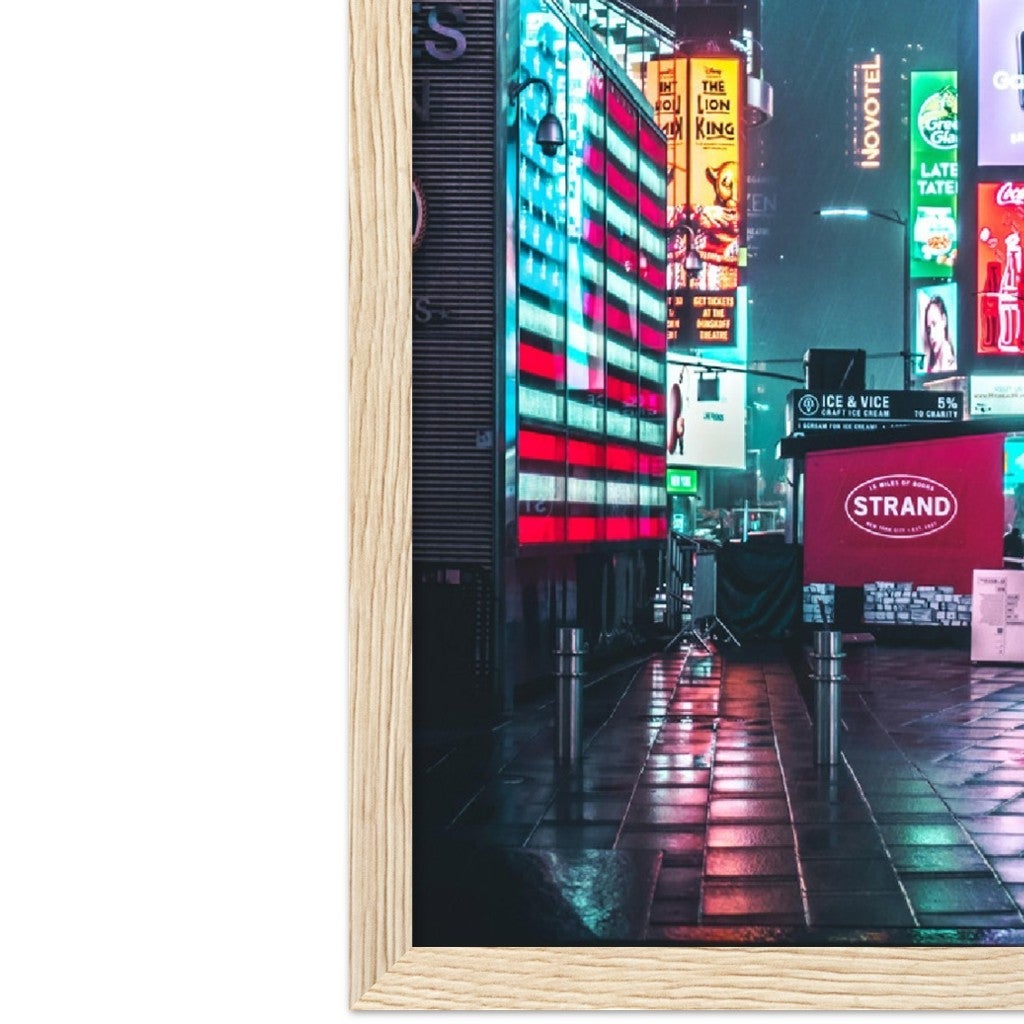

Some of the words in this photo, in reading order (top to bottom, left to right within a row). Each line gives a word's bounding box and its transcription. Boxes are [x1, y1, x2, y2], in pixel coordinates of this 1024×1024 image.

[702, 80, 724, 92] THE
[698, 95, 730, 114] LION
[861, 53, 881, 168] NOVOTEL
[696, 116, 735, 140] KING
[917, 179, 958, 195] TATE
[702, 308, 711, 318] AT
[712, 308, 725, 318] THE
[822, 394, 844, 408] ICE
[847, 395, 857, 408] &
[860, 395, 890, 408] VICE
[937, 396, 958, 409] 5%
[820, 408, 846, 416] CRAFT
[848, 409, 861, 417] ICE
[863, 410, 890, 418] CREAM
[914, 409, 924, 418] TO
[926, 410, 958, 418] CHARITY
[853, 496, 951, 516] STRAND
